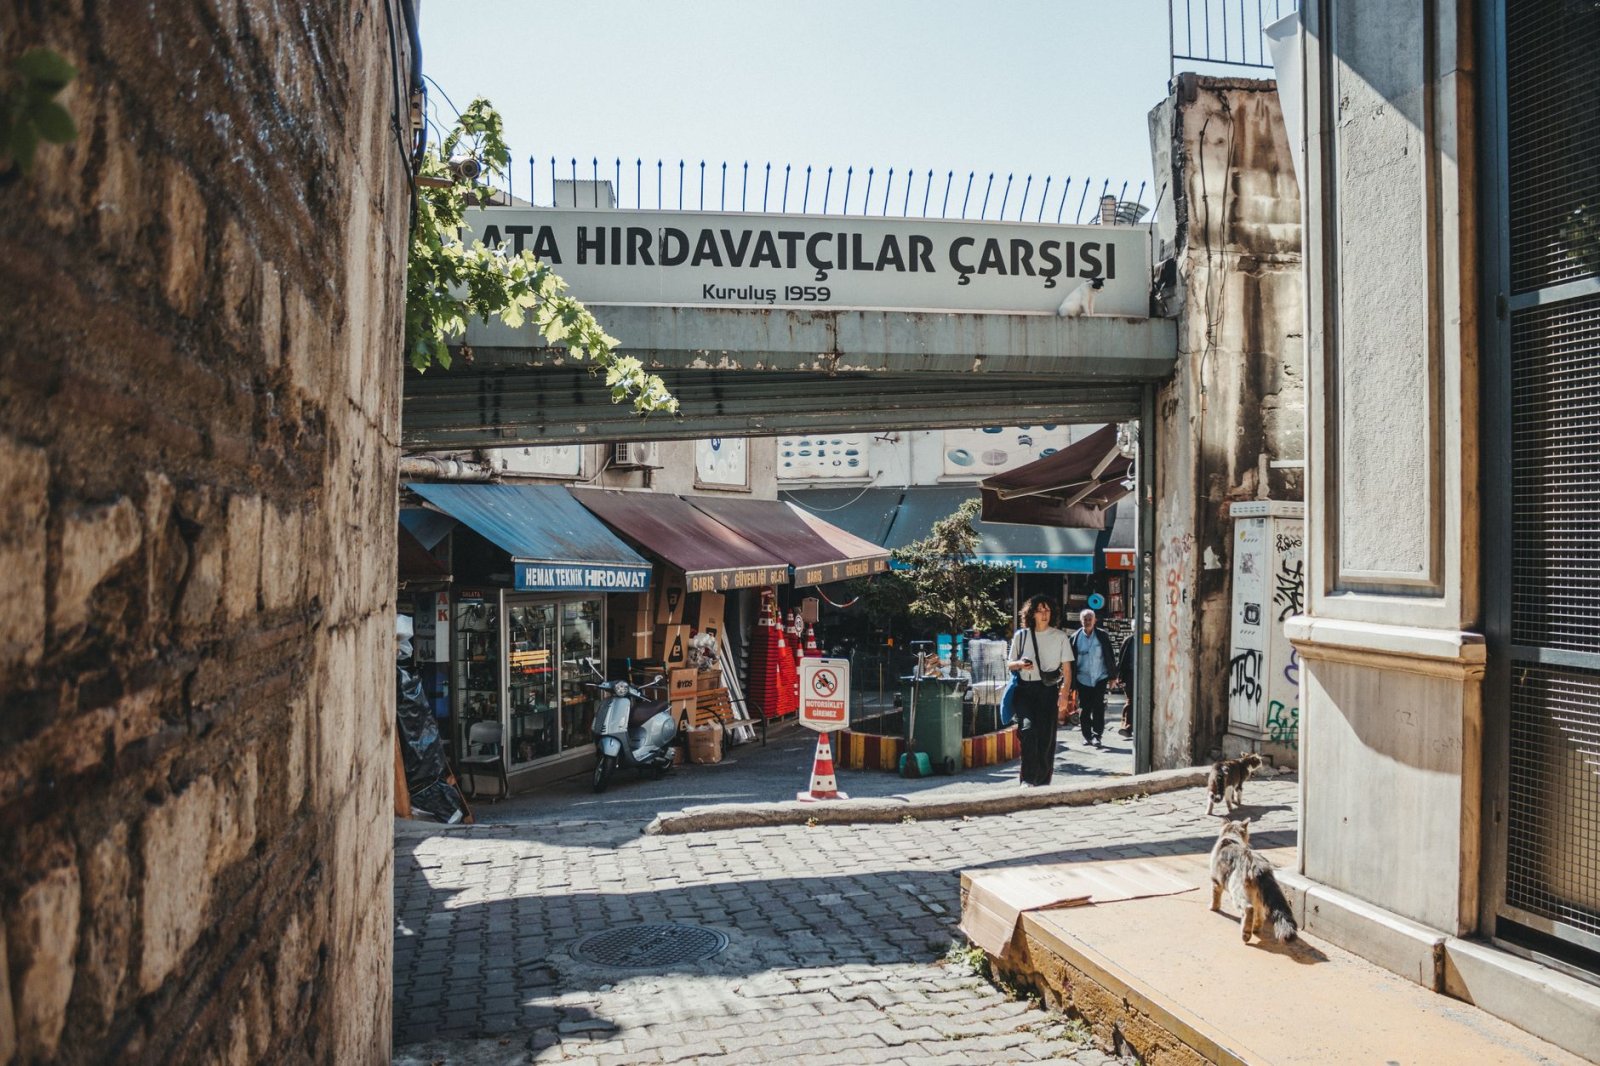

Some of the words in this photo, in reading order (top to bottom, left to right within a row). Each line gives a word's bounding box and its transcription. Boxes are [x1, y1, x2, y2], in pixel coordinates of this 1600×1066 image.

[577, 225, 936, 282] HIRDAVATÇILAR
[949, 236, 1116, 289] ÇARŞISI
[702, 284, 777, 305] Kuruluş
[784, 285, 832, 302] 1959
[1034, 560, 1048, 570] 76
[525, 567, 555, 586] HEMAK
[585, 569, 646, 588] HIRDAVAT
